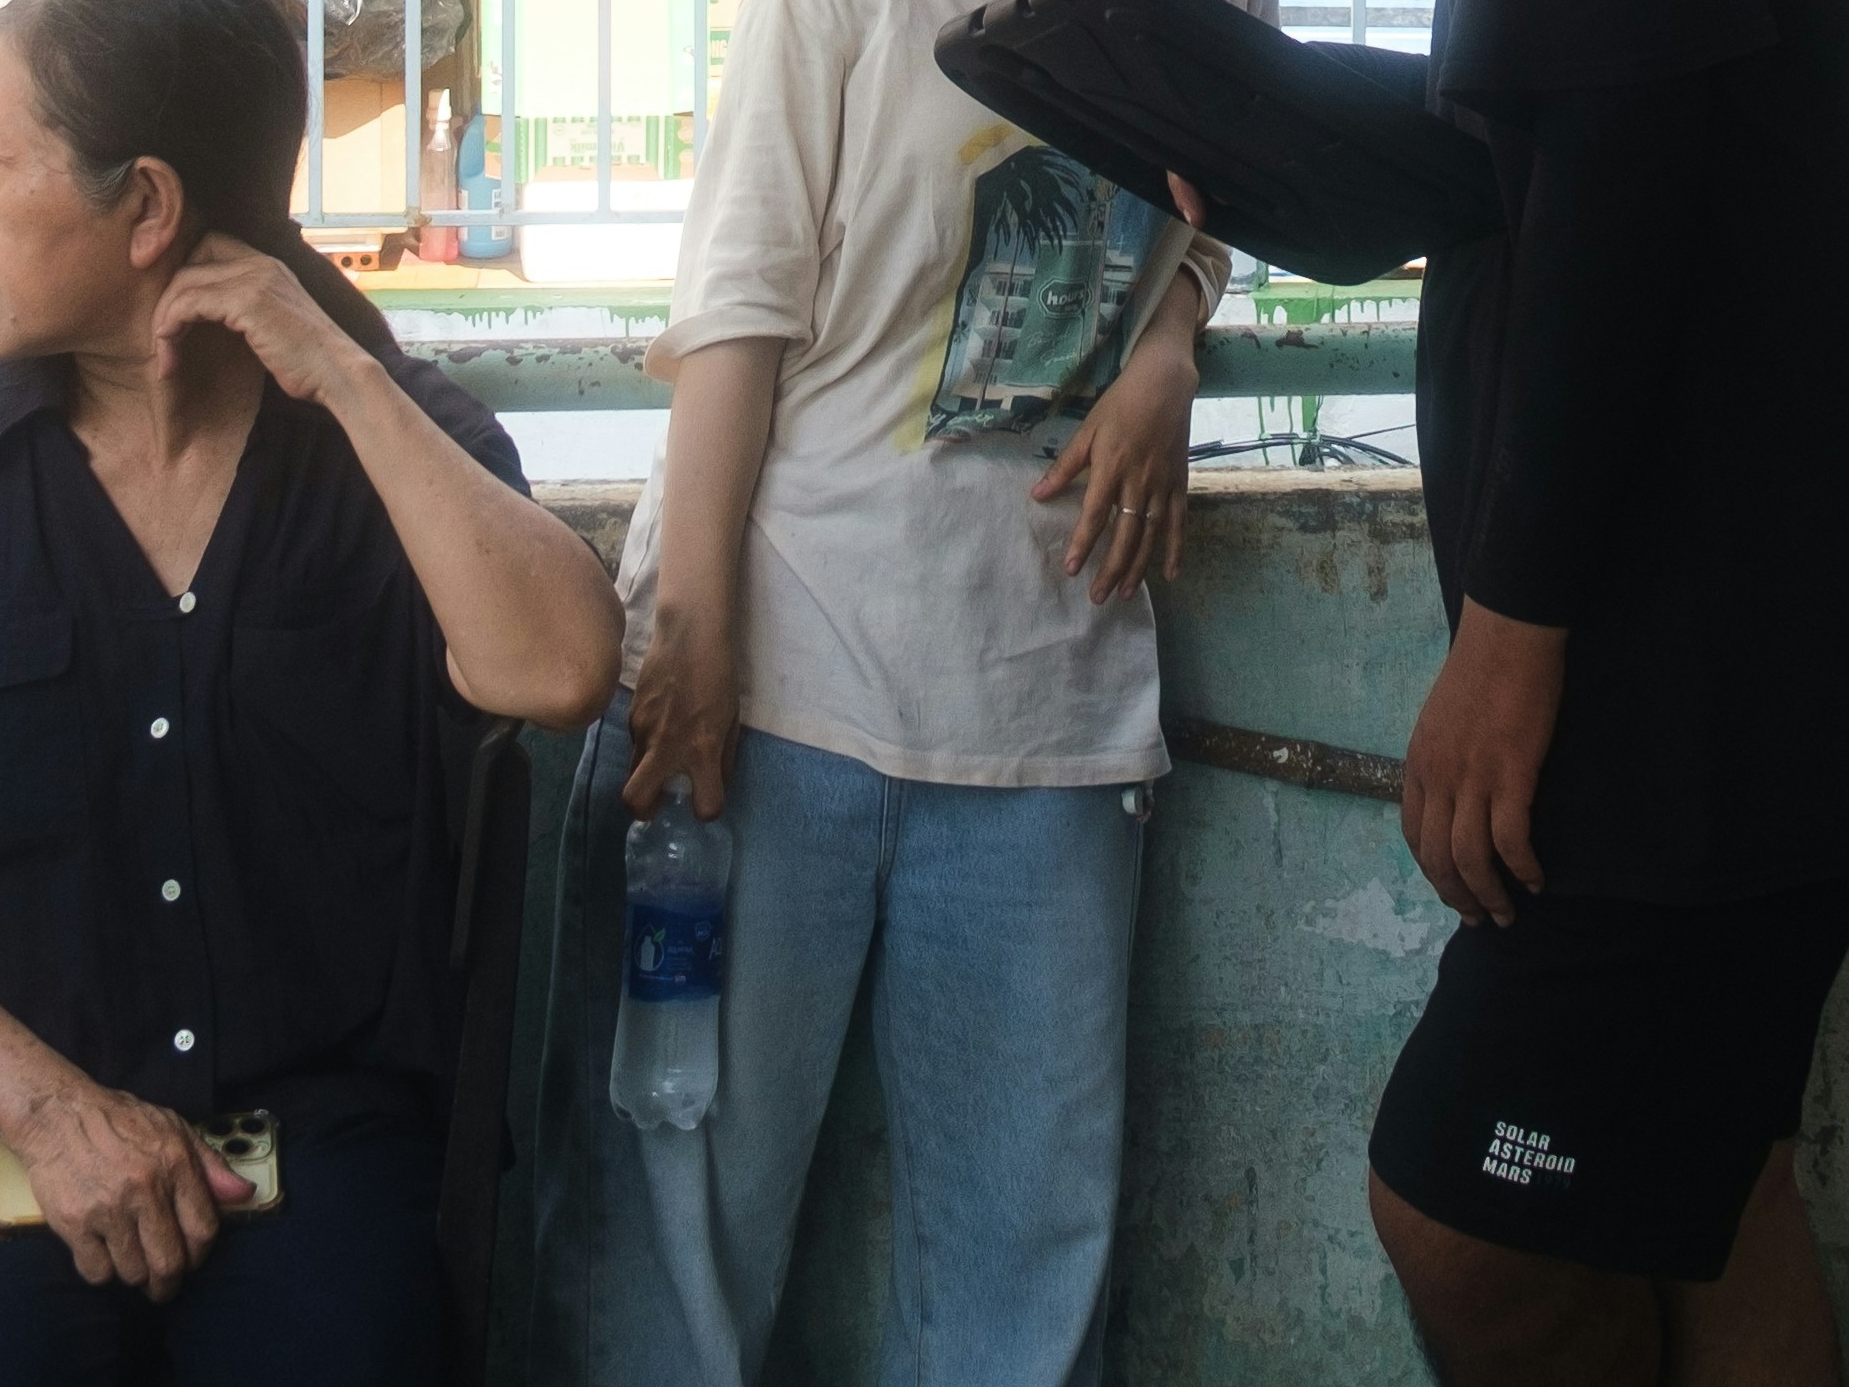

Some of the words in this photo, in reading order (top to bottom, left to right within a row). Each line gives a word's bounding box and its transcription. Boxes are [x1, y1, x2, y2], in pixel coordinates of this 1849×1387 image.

[1494, 1121, 1551, 1151] SOLAR
[1482, 1156, 1533, 1185] MARS
[1488, 1139, 1576, 1174] ASTEROID
